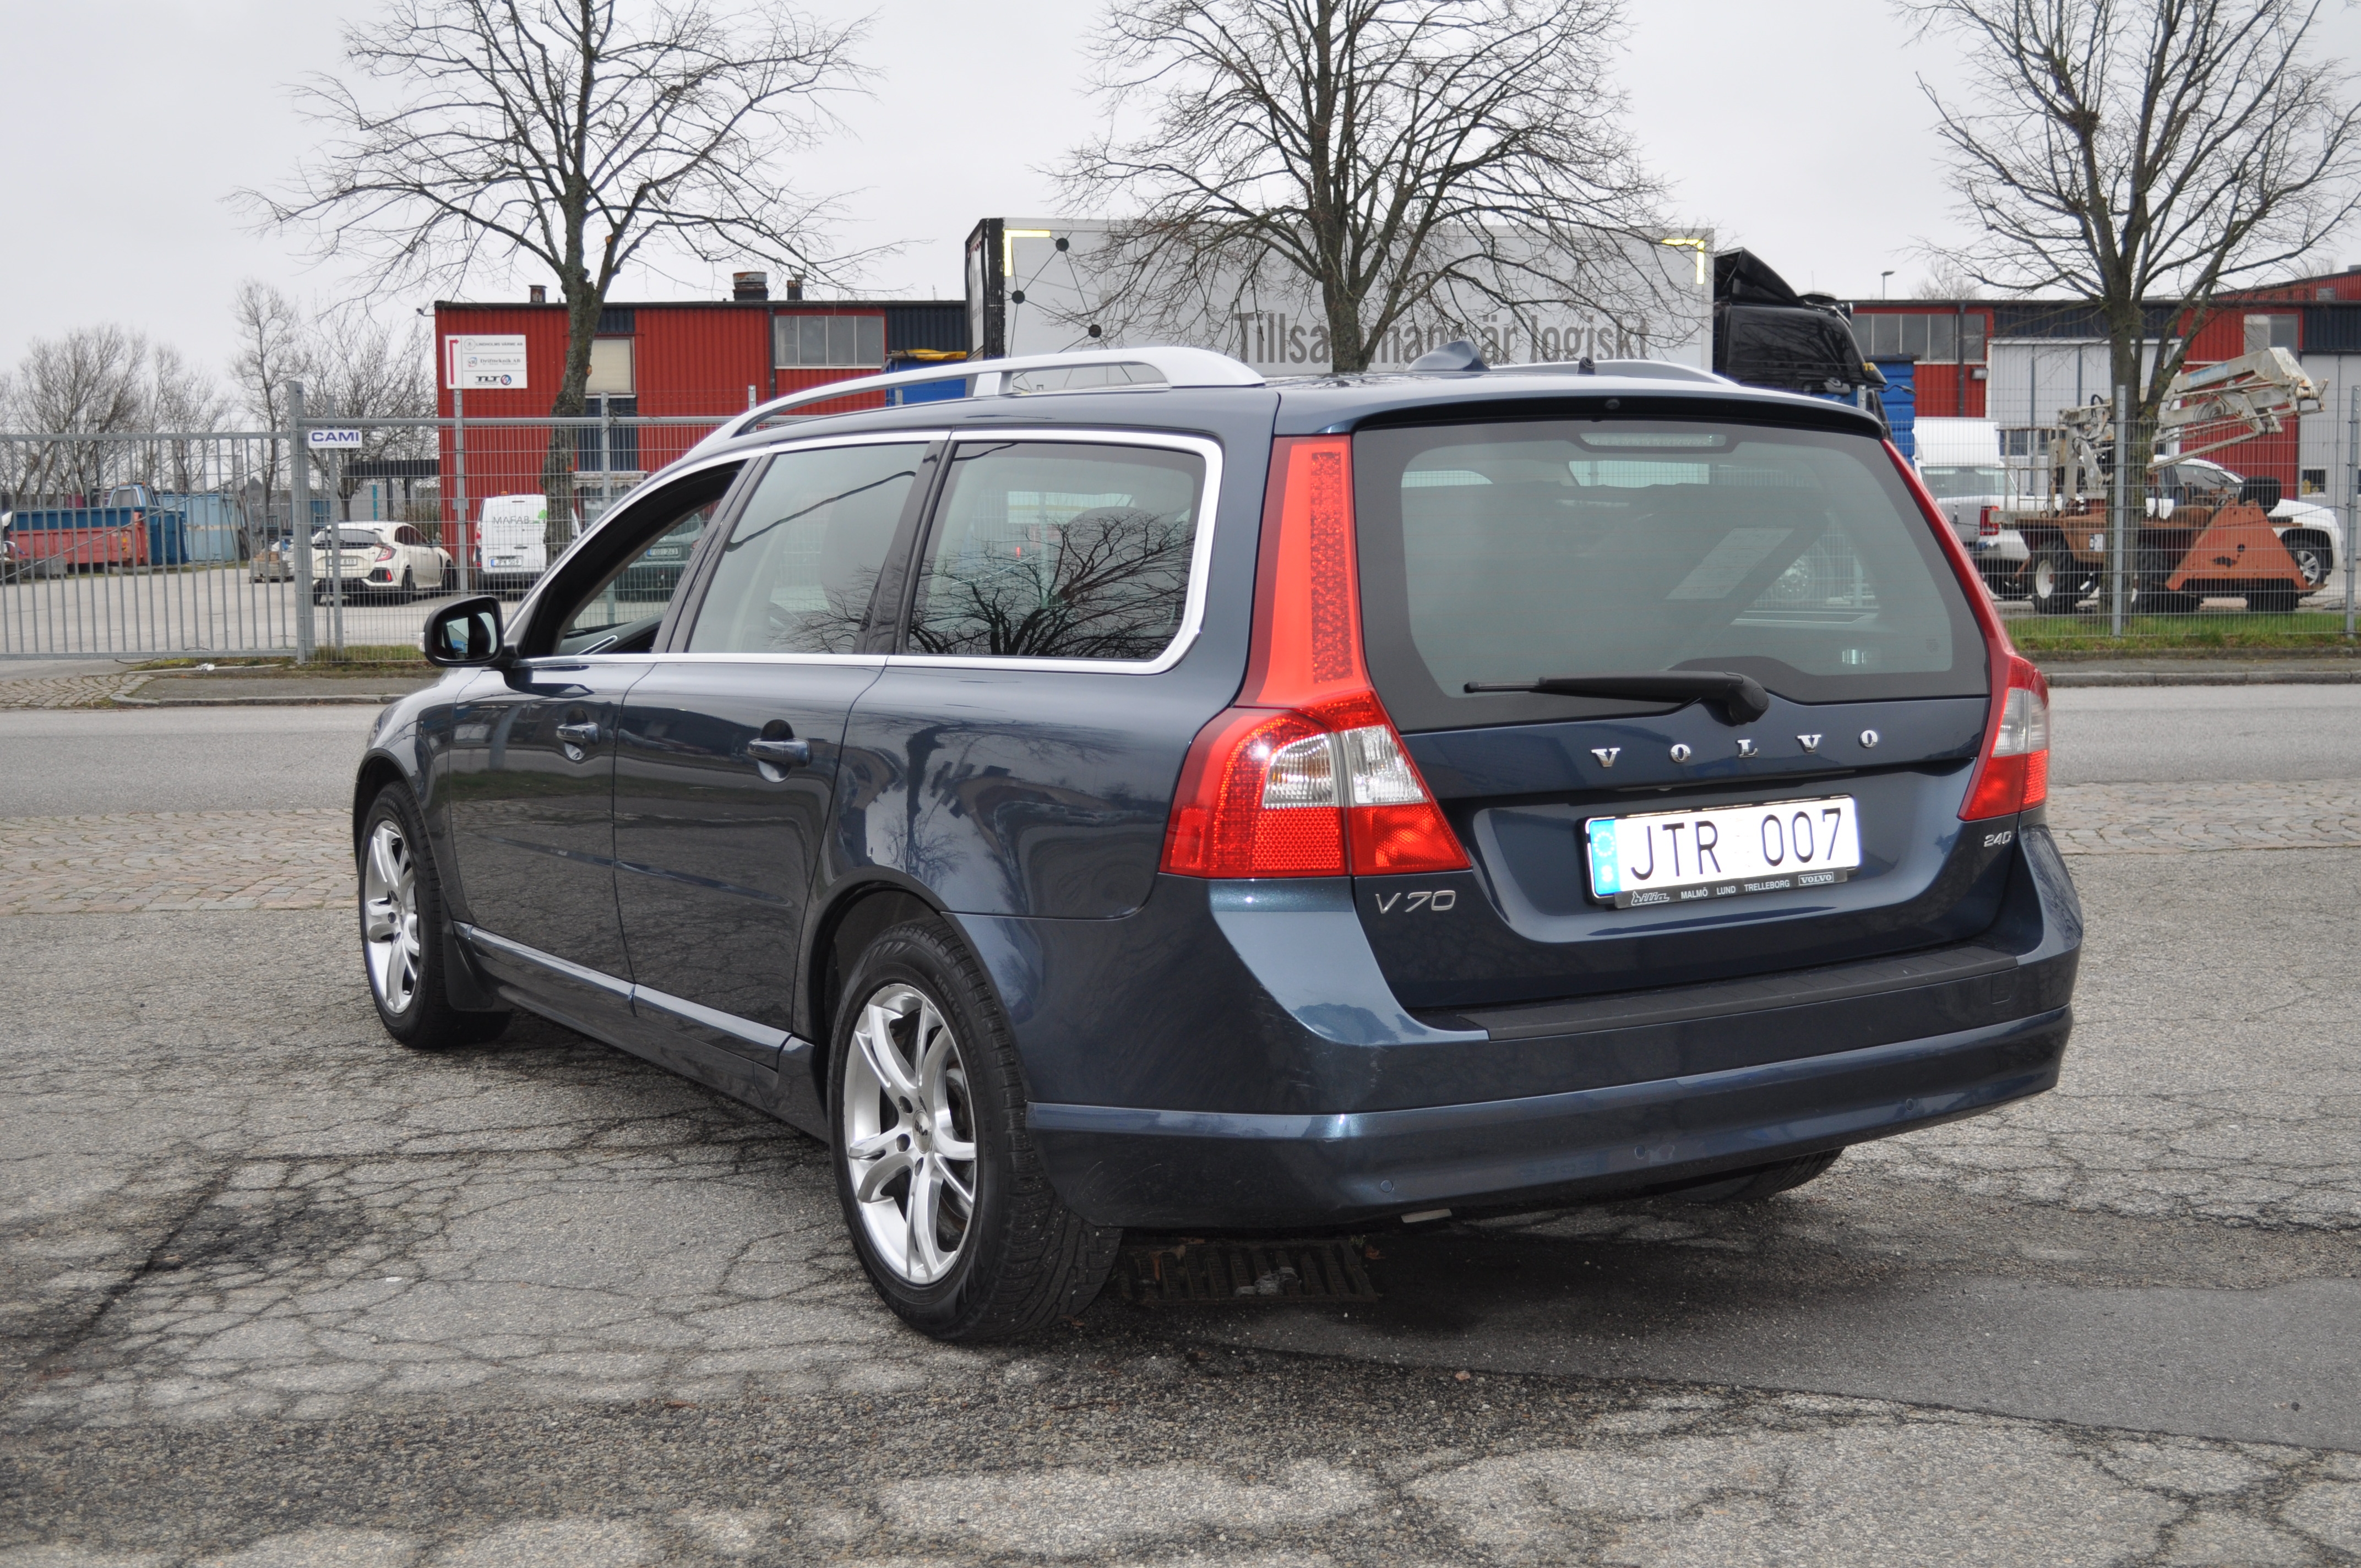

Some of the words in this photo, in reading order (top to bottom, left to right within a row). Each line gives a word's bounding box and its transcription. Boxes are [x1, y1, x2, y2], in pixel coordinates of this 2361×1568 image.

[1234, 313, 1467, 363] Tillsaman
[1480, 314, 1517, 364] är
[1531, 314, 1650, 363] logiskt
[312, 432, 359, 442] CAMI
[1591, 730, 1879, 767] VOLVO
[1630, 820, 1721, 880] JTR
[1761, 807, 1841, 867] 007
[1681, 887, 1708, 899] MALMÖ
[1716, 885, 1736, 895] LUND
[1744, 880, 1790, 892] TRELLEBORG
[1799, 873, 1832, 884] VOLVO
[1375, 890, 1456, 914] V70
